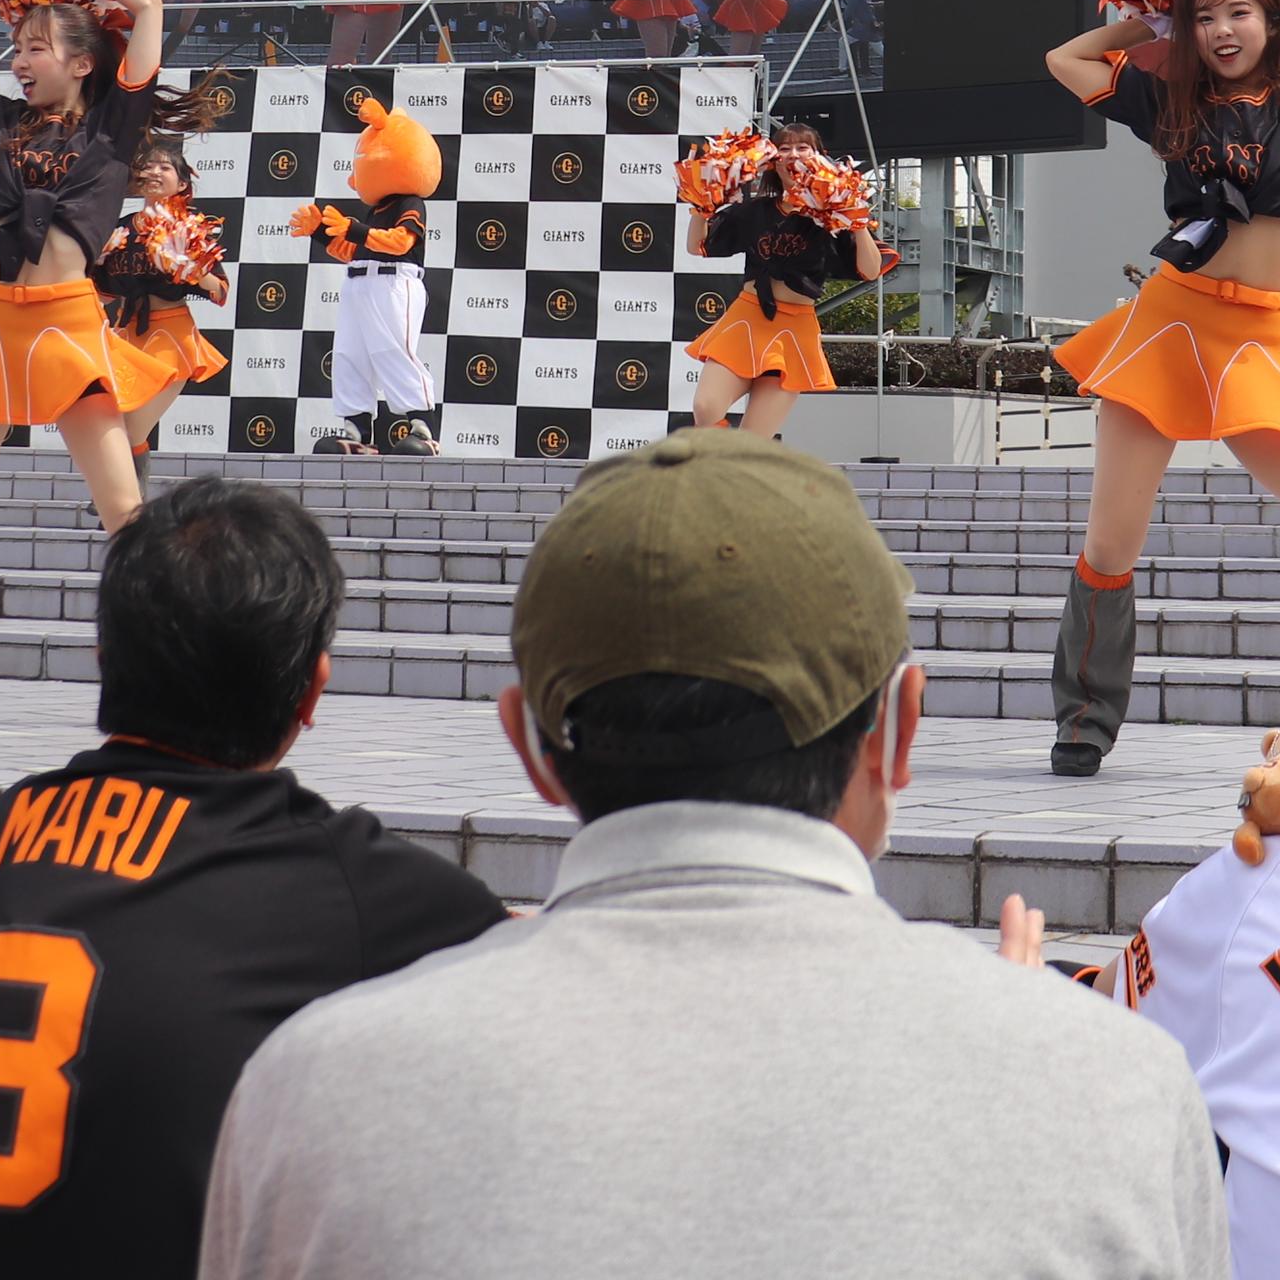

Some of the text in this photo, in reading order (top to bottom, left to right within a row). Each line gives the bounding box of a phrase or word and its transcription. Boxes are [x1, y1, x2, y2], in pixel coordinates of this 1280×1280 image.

[270, 94, 309, 106] GIANTS
[408, 95, 448, 107] GIANTS
[550, 95, 592, 107] GIANTS
[695, 95, 738, 108] GIANTS
[197, 159, 235, 172] GIANTS
[474, 162, 516, 174] GIANTS
[619, 163, 662, 175] GIANTS
[257, 224, 294, 236] GIANT
[543, 230, 585, 243] GIANTS
[466, 297, 509, 310] GIANTS
[614, 300, 658, 313] GIANTS
[247, 357, 286, 369] GIANTS
[535, 367, 578, 380] GIANTS
[174, 424, 214, 436] GIANTS
[310, 427, 346, 438] GIANT
[456, 433, 500, 446] GIANTS
